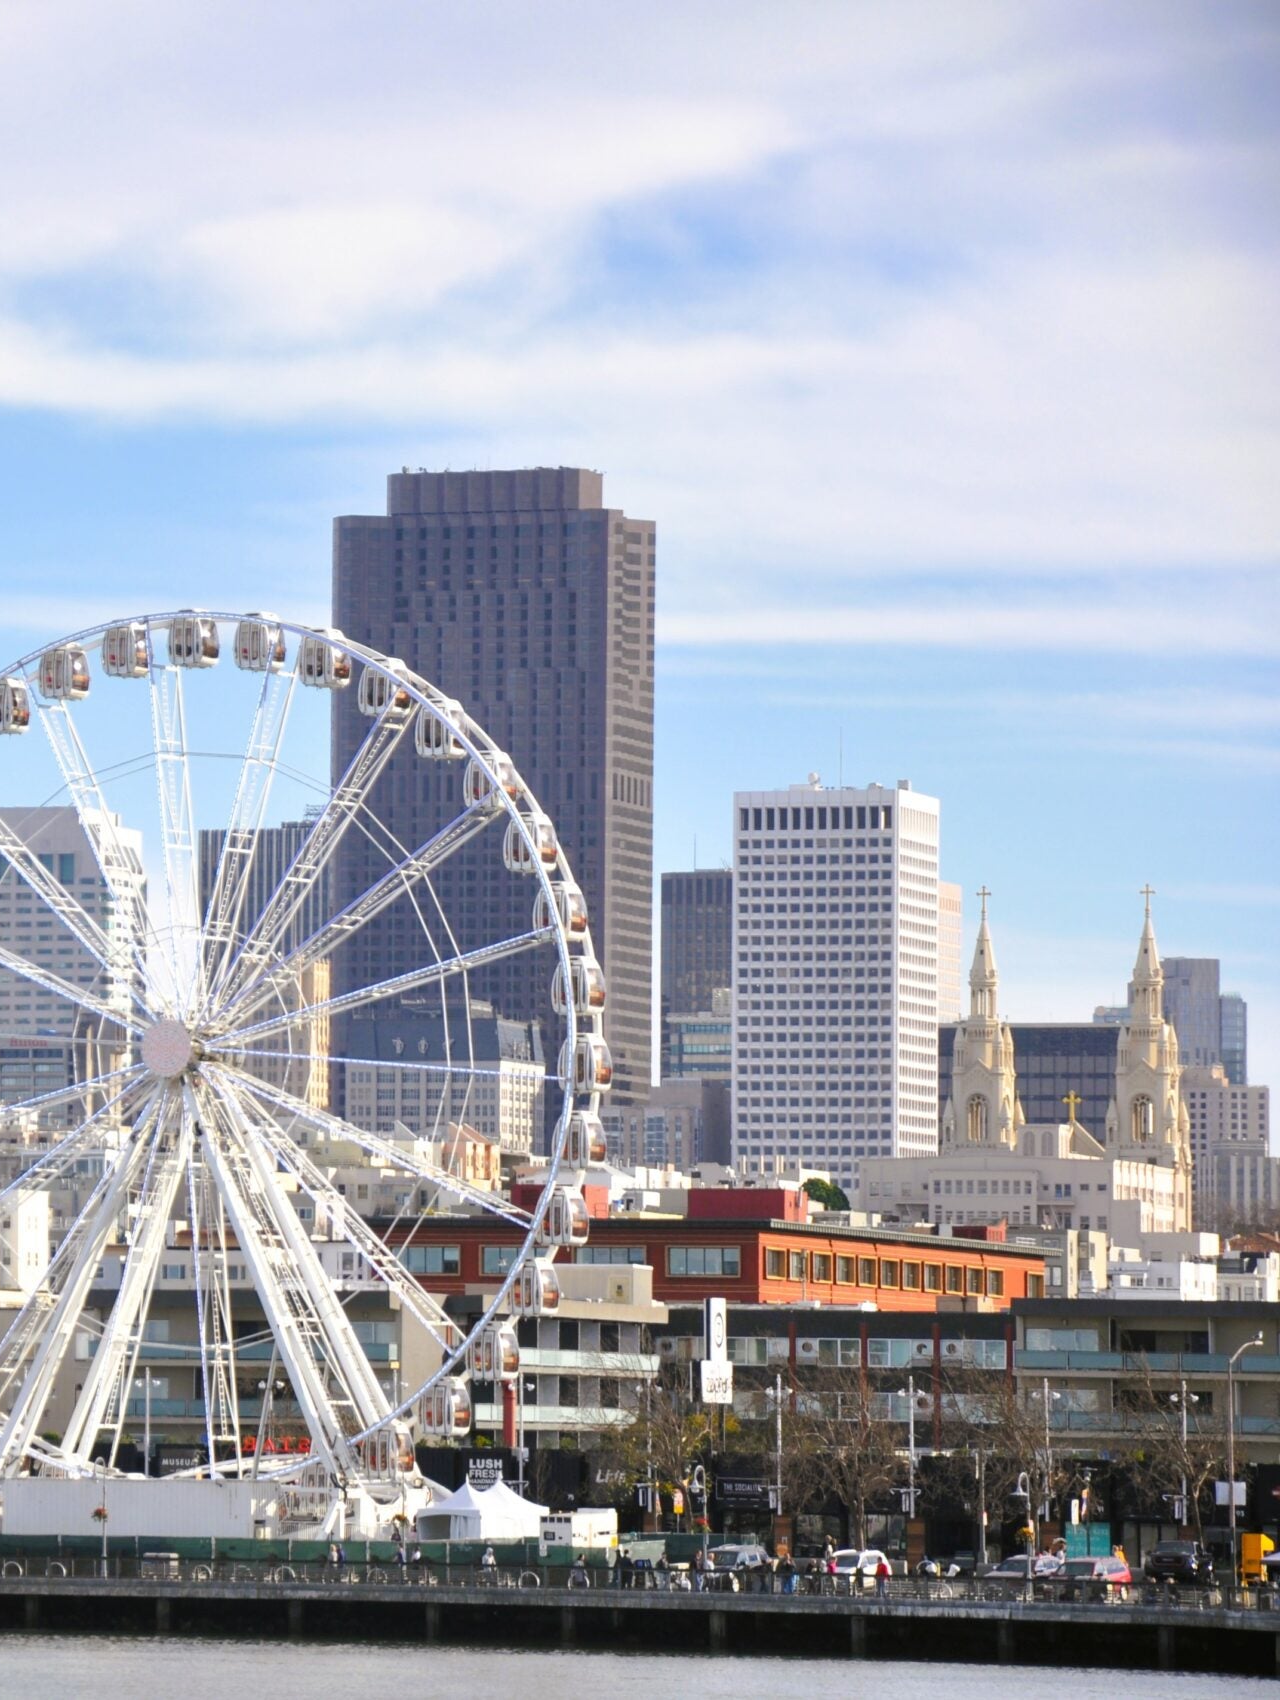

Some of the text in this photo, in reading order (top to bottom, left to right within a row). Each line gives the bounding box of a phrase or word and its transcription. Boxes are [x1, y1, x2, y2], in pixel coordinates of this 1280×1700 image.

[469, 1458, 503, 1469] LUSH
[723, 1482, 761, 1491] THE SOCIALIT
